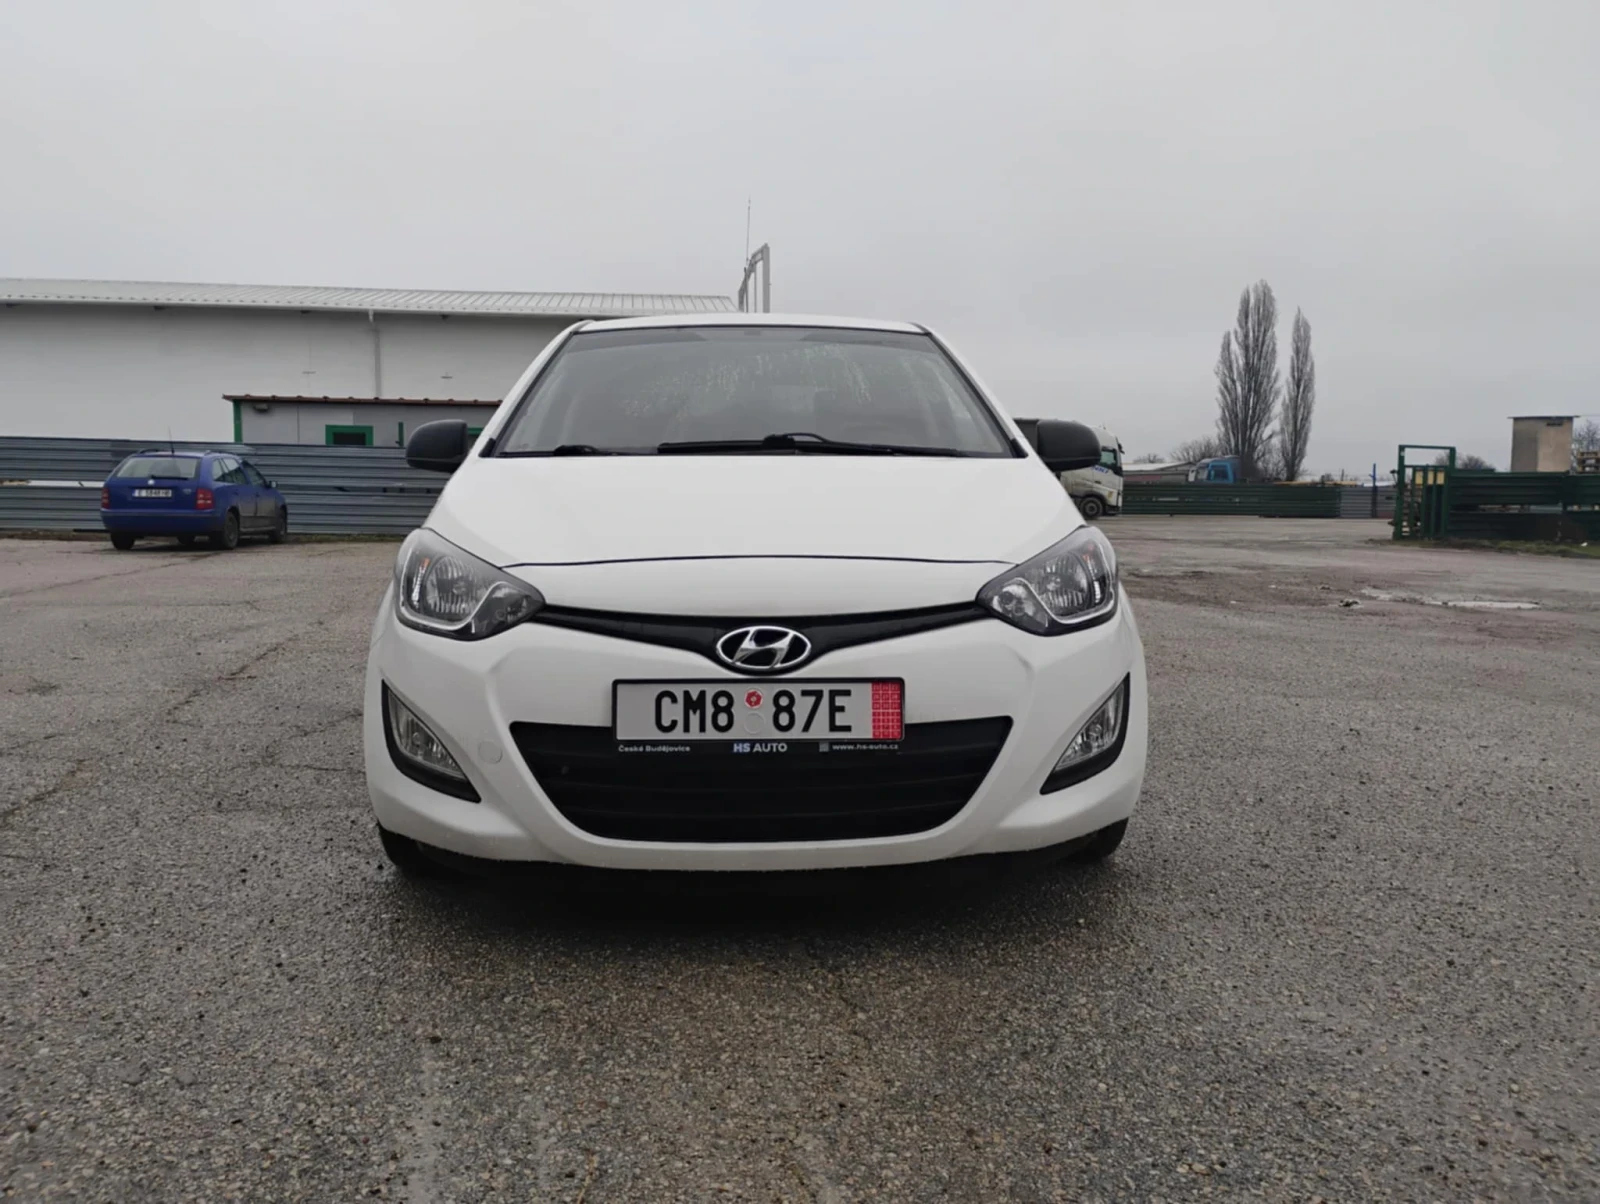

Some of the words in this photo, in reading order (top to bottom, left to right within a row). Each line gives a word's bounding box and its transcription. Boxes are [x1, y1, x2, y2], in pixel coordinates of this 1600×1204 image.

[655, 690, 735, 733] CM8
[772, 689, 852, 733] 87E
[618, 744, 643, 752] České
[645, 745, 691, 753] Budějovice
[733, 743, 751, 753] HS
[753, 743, 788, 753] AUTO
[832, 743, 899, 751] www.hs-auto.cz
